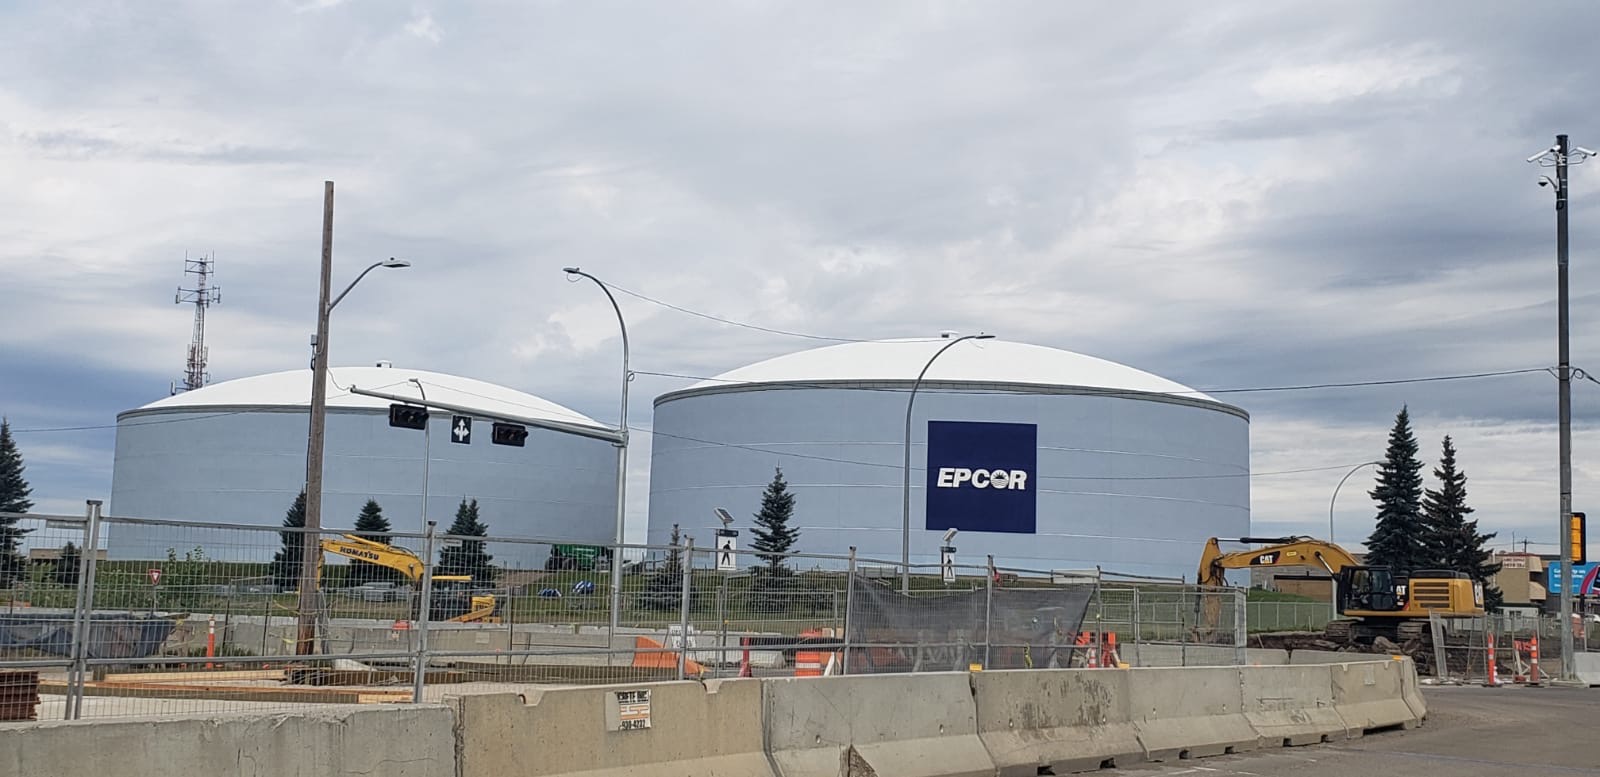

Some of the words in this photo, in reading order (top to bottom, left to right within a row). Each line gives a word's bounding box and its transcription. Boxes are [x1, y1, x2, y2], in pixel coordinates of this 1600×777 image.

[937, 467, 1027, 490] EPCOR
[340, 547, 379, 560] KOMATSU
[1259, 555, 1273, 564] CAT
